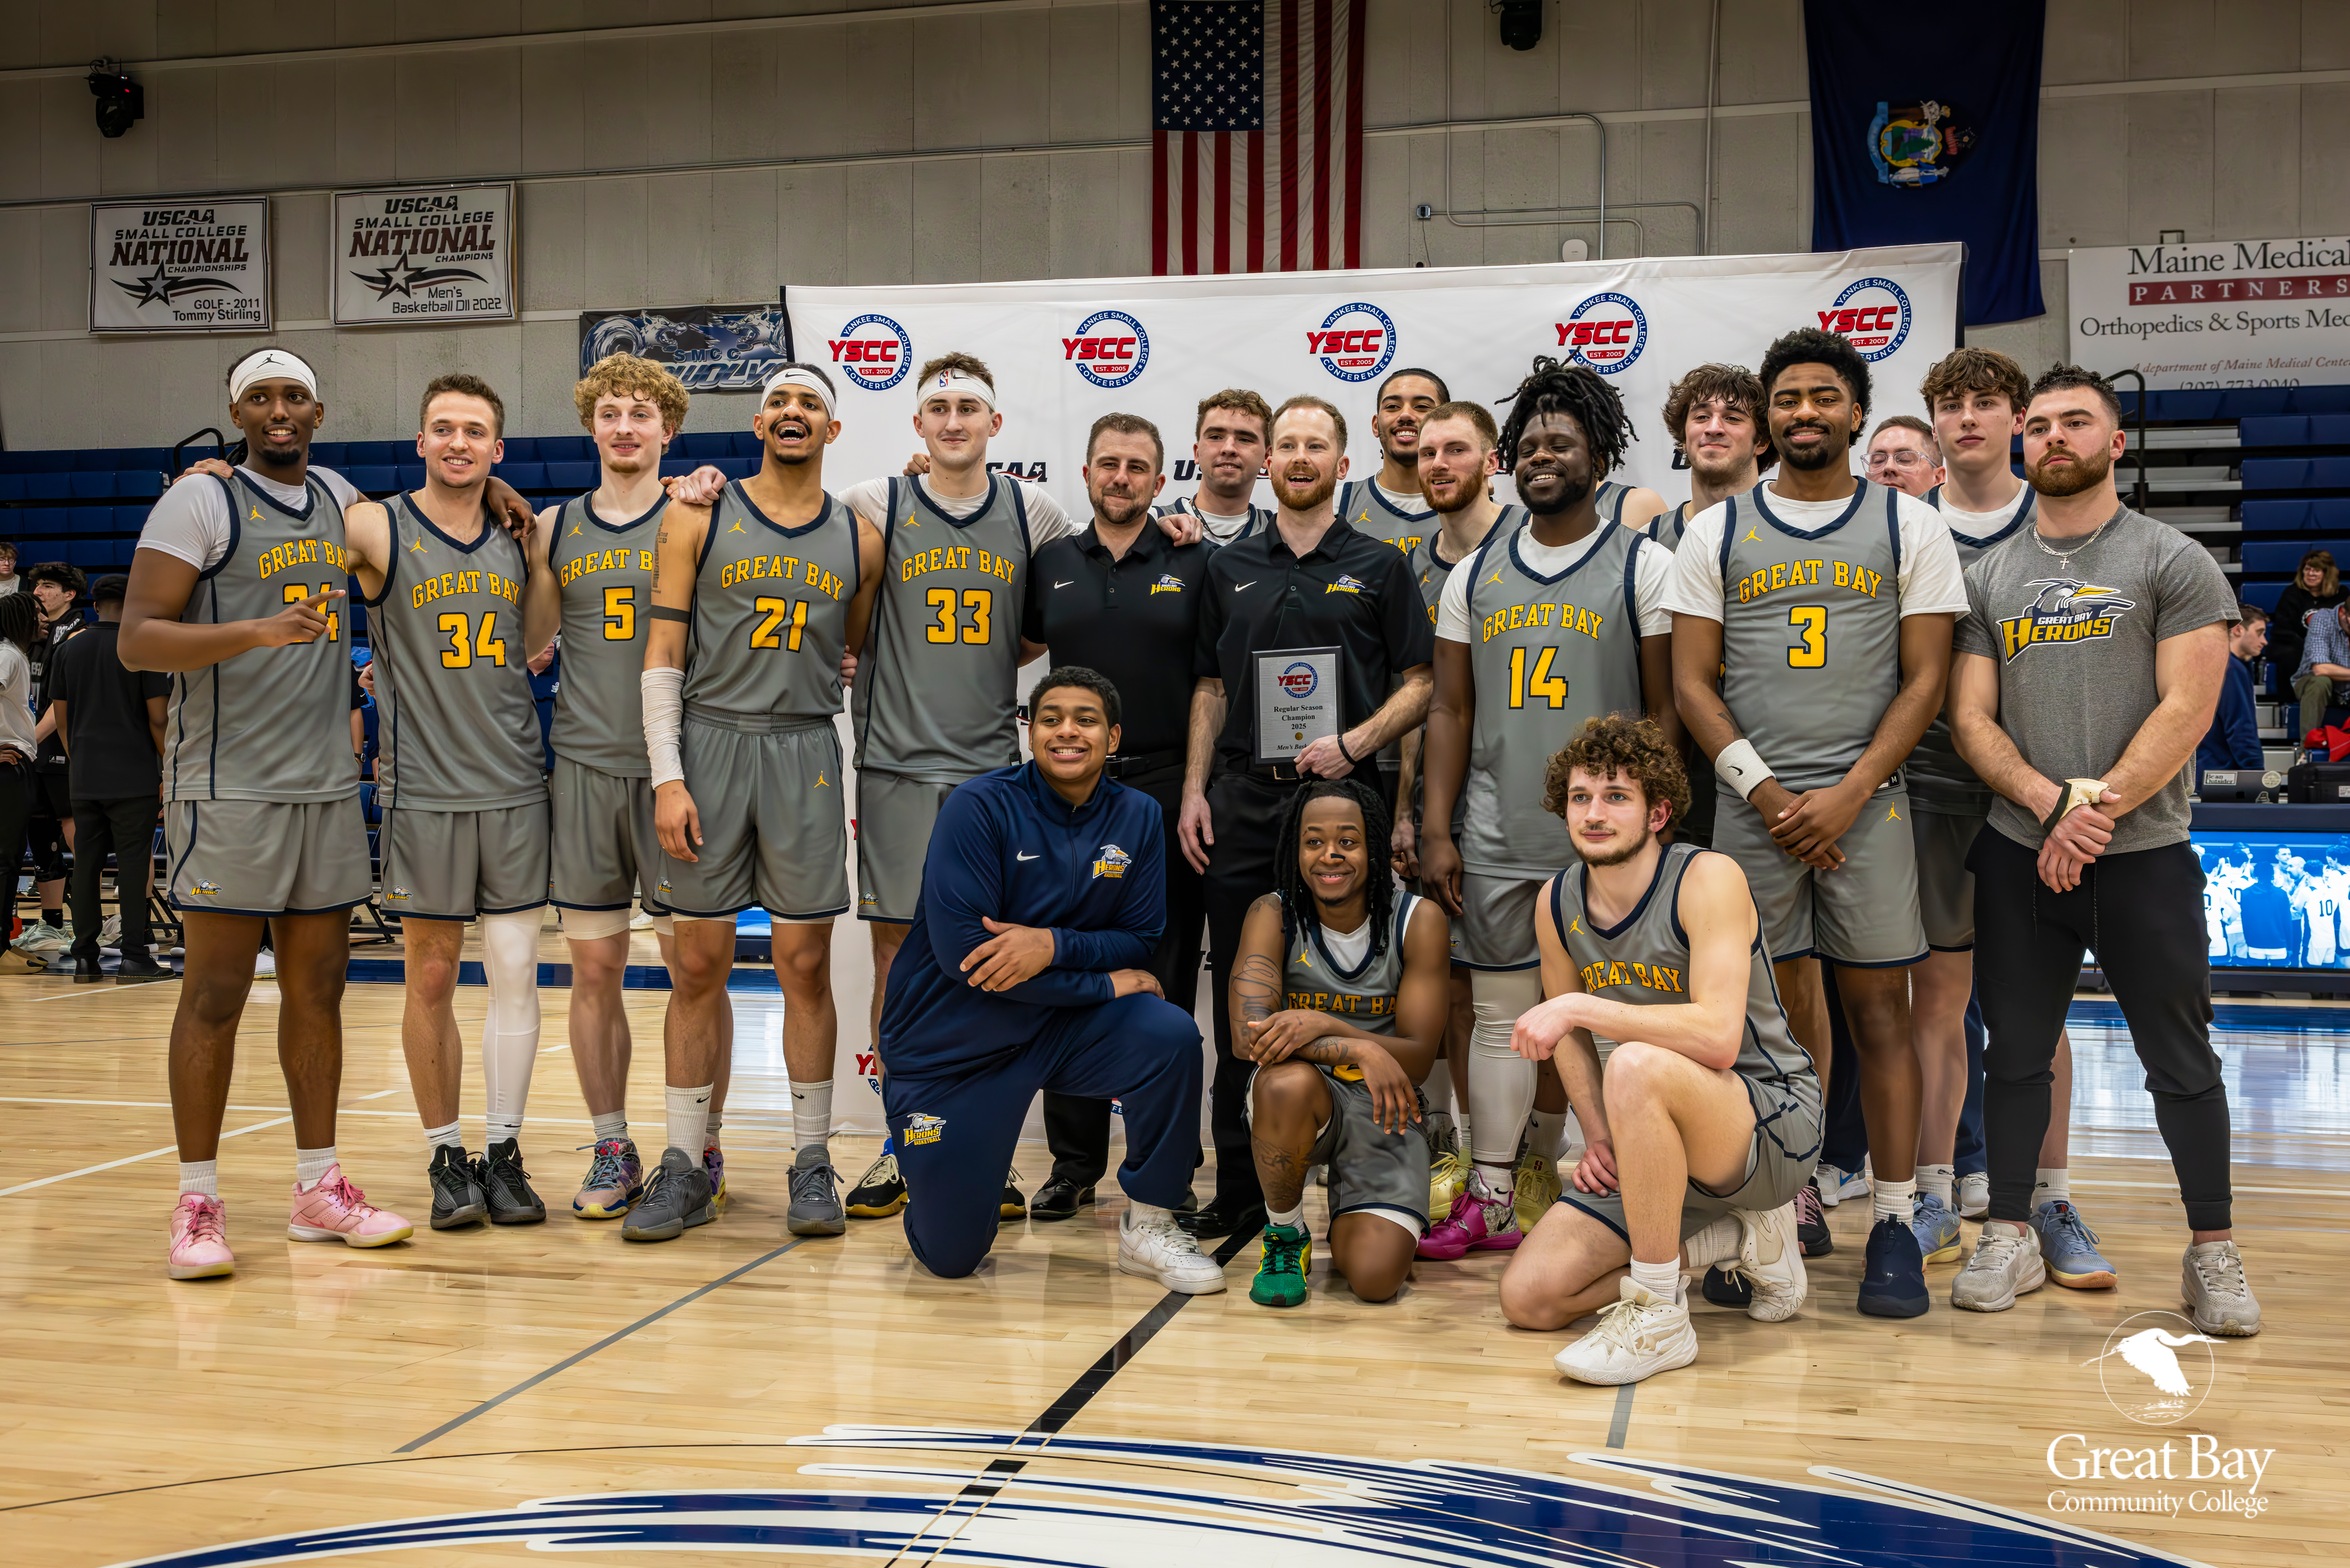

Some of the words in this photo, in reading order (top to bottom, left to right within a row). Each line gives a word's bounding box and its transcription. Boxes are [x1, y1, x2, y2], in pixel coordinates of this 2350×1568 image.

[142, 209, 215, 226] USCAA
[385, 195, 458, 214] USCAA
[115, 228, 170, 240] SMALL
[175, 225, 247, 238] COLLEGE
[354, 216, 413, 229] SMALL
[419, 211, 494, 227] COLLEGE
[109, 237, 250, 266] NATIONAL
[349, 224, 496, 257] NATIONAL
[167, 264, 247, 273] CHAMPIONSHIPS
[435, 252, 493, 263] CHAMPIONS
[2127, 246, 2224, 275] Maine
[194, 299, 224, 310] GOLF
[233, 298, 260, 309] 2011
[427, 286, 463, 299] Men's
[2135, 278, 2348, 302] PARTNERS
[173, 310, 215, 322] Tommy
[217, 309, 261, 321] Stirling
[392, 301, 453, 314] Basketball
[473, 297, 502, 310] 2022
[1817, 305, 1898, 333] YSCC
[1837, 280, 1870, 304] YANKEE
[1873, 279, 1899, 295] SMALL
[1899, 294, 1910, 335] COLLEGE
[1325, 305, 1356, 326] YANKEE
[1358, 304, 1383, 319] SMALL
[1383, 319, 1395, 357] COLLEGE
[1555, 320, 1634, 346] YSCC
[1574, 295, 1606, 316] YANKEE
[1608, 294, 1634, 310] SMALL
[1634, 309, 1646, 348] COLLEGE
[2080, 314, 2203, 341] Orthopedics
[2208, 312, 2233, 331] &
[2236, 311, 2300, 336] Sports
[828, 340, 899, 362] YSCC
[843, 316, 872, 335] YANKEE
[873, 316, 898, 331] SMALL
[898, 331, 910, 367] COLLEGE
[1062, 337, 1136, 360] YSCC
[1079, 313, 1109, 333] YANKEE
[1111, 312, 1136, 328] SMALL
[1136, 327, 1148, 364] COLLEGE
[1306, 329, 1383, 354] YSCC
[845, 367, 904, 389] CONFERENCE
[1079, 365, 1140, 387] CONFERENCE
[1323, 358, 1386, 381] CONFERENCE
[2143, 362, 2207, 377] department
[2210, 360, 2225, 375] of
[2225, 359, 2262, 371] Maine
[2266, 357, 2313, 369] Medical
[2315, 356, 2350, 368] Cente
[258, 539, 318, 580] GREAT
[560, 548, 631, 588] GREAT
[902, 546, 971, 583] GREAT
[978, 549, 1015, 585] BAY
[411, 570, 482, 609] GREAT
[487, 572, 521, 606] BAY
[720, 555, 799, 590] GREAT
[804, 561, 845, 602] BAY
[1738, 559, 1824, 604] GREAT
[1832, 560, 1883, 599] BAY
[602, 585, 635, 641] 5
[749, 595, 809, 653] 21
[925, 587, 993, 645] 33
[1482, 603, 1556, 644] GREAT
[1560, 603, 1603, 641] BAY
[2037, 616, 2074, 625] GREAT
[2074, 611, 2093, 623] BAY
[437, 611, 506, 669] 34
[1787, 605, 1828, 669] 3
[2002, 617, 2111, 659] HERONS
[1277, 674, 1312, 687] YSCC
[1508, 646, 1569, 710] 14
[1273, 705, 1299, 713] Regular
[1281, 714, 1316, 722] Champion
[2319, 899, 2333, 917] 10
[1580, 961, 1632, 993] REAT
[1632, 962, 1684, 993] BAY
